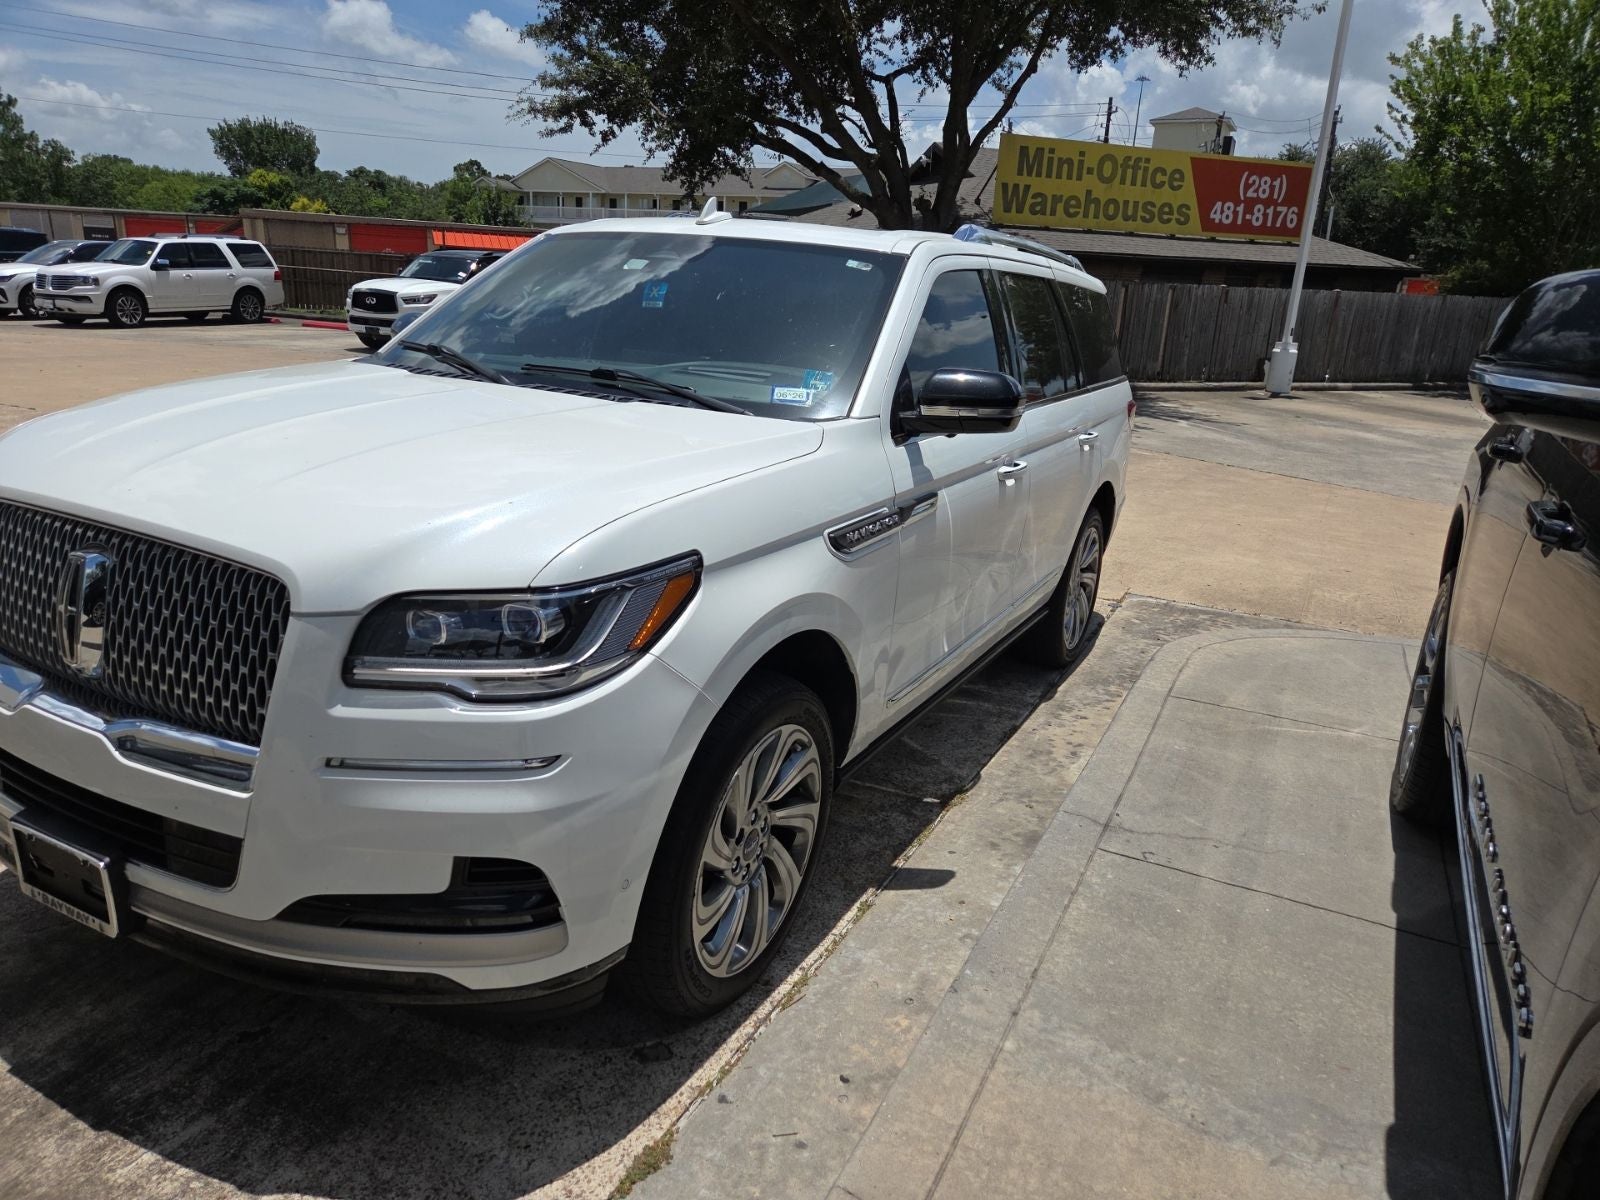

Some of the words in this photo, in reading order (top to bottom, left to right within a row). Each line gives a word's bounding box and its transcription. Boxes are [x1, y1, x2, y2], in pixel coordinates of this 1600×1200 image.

[1016, 145, 1185, 191] Mini-Office
[1239, 170, 1287, 203] (281)
[1001, 182, 1191, 226] Warehouses
[1210, 201, 1298, 229] 481-8176
[846, 514, 899, 540] NAVIGATOR
